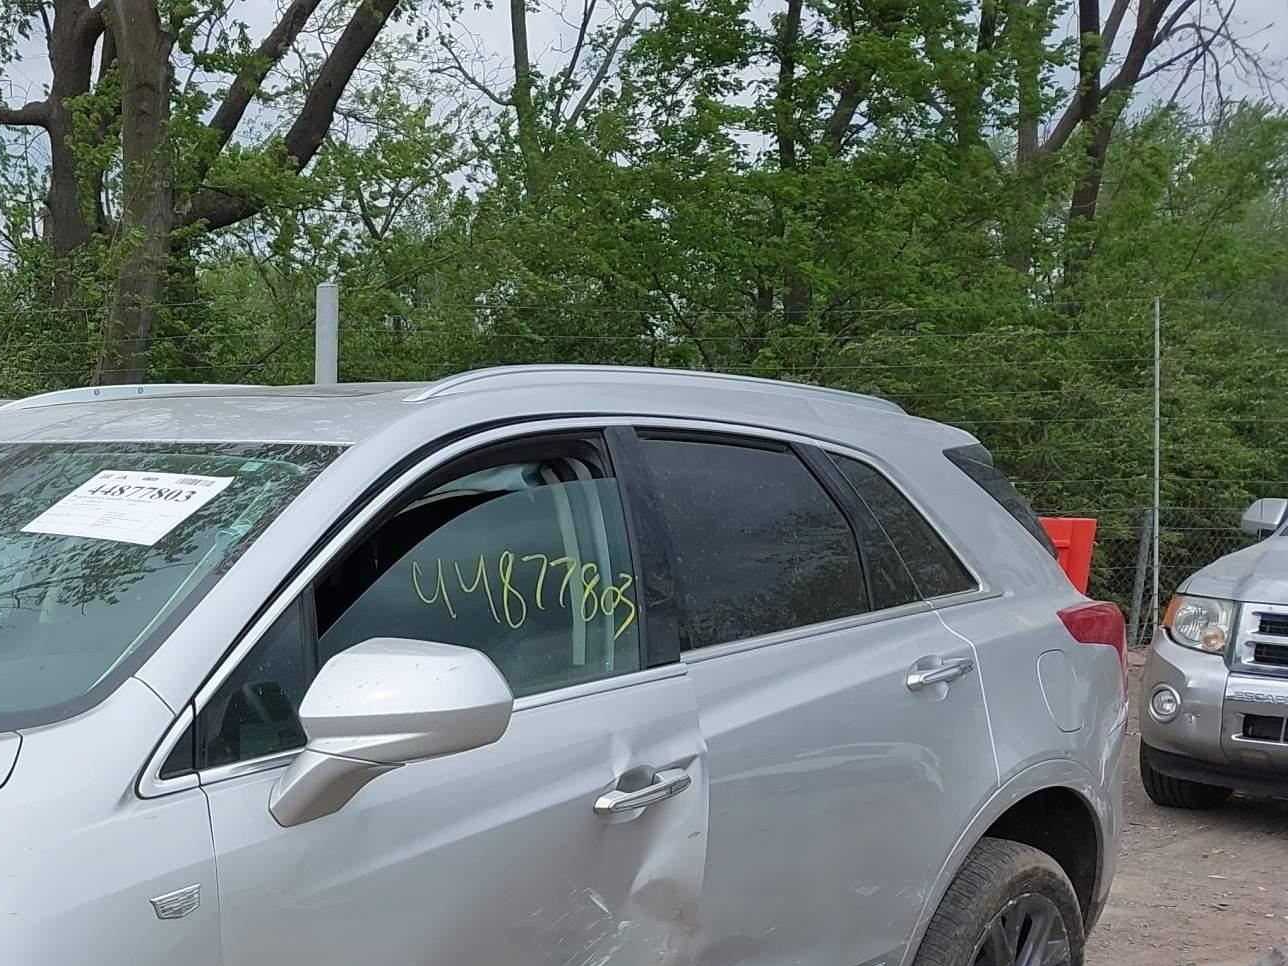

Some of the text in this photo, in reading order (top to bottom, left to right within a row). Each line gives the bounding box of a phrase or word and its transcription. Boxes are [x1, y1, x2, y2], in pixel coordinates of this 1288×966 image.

[88, 483, 197, 503] 44877803
[413, 551, 636, 641] 44877803
[1234, 691, 1288, 704] ESCAP
